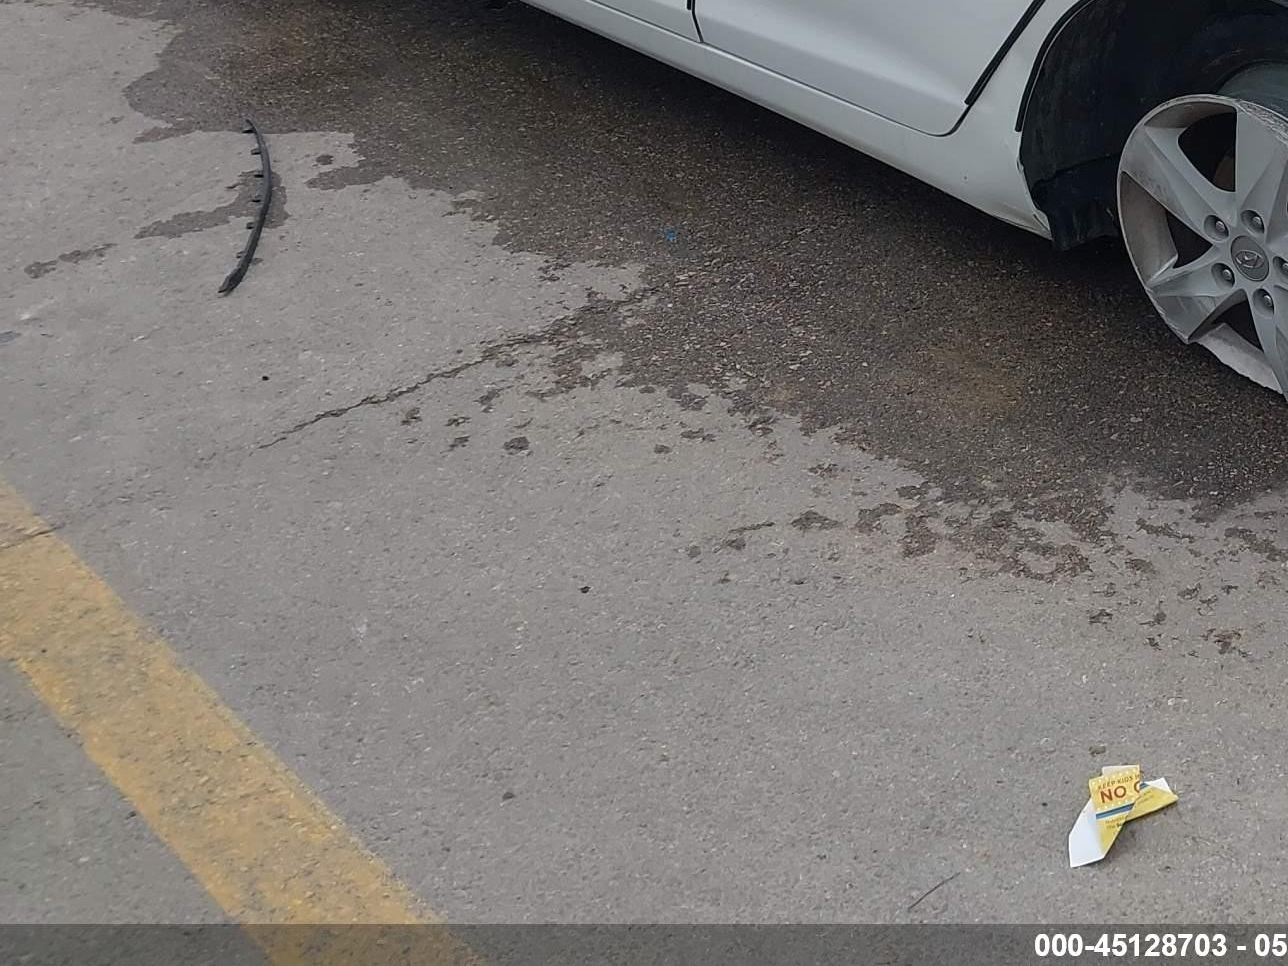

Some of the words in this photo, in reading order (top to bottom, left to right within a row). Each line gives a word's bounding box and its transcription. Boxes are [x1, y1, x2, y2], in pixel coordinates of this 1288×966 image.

[1098, 781, 1116, 790] KEEP
[1117, 775, 1133, 784] KIDS
[1100, 785, 1127, 803] NO
